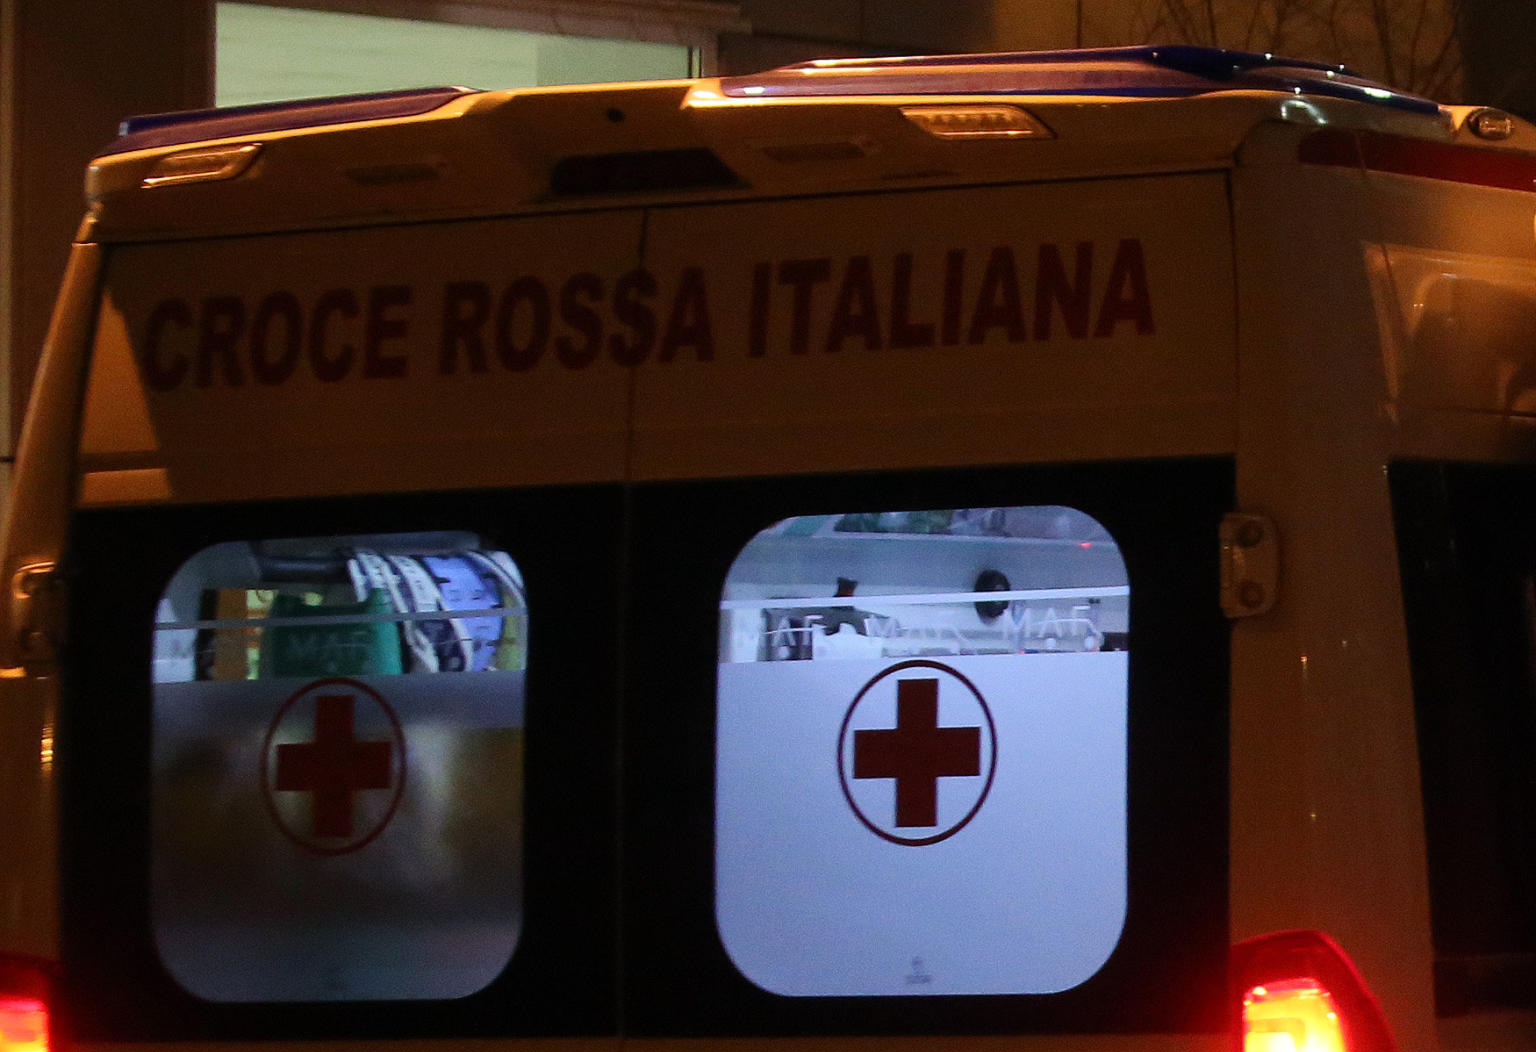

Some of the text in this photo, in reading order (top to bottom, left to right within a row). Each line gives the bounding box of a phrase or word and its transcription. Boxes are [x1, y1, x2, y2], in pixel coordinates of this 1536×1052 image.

[141, 238, 1157, 392] CROCE ROSSA ITALIANA
